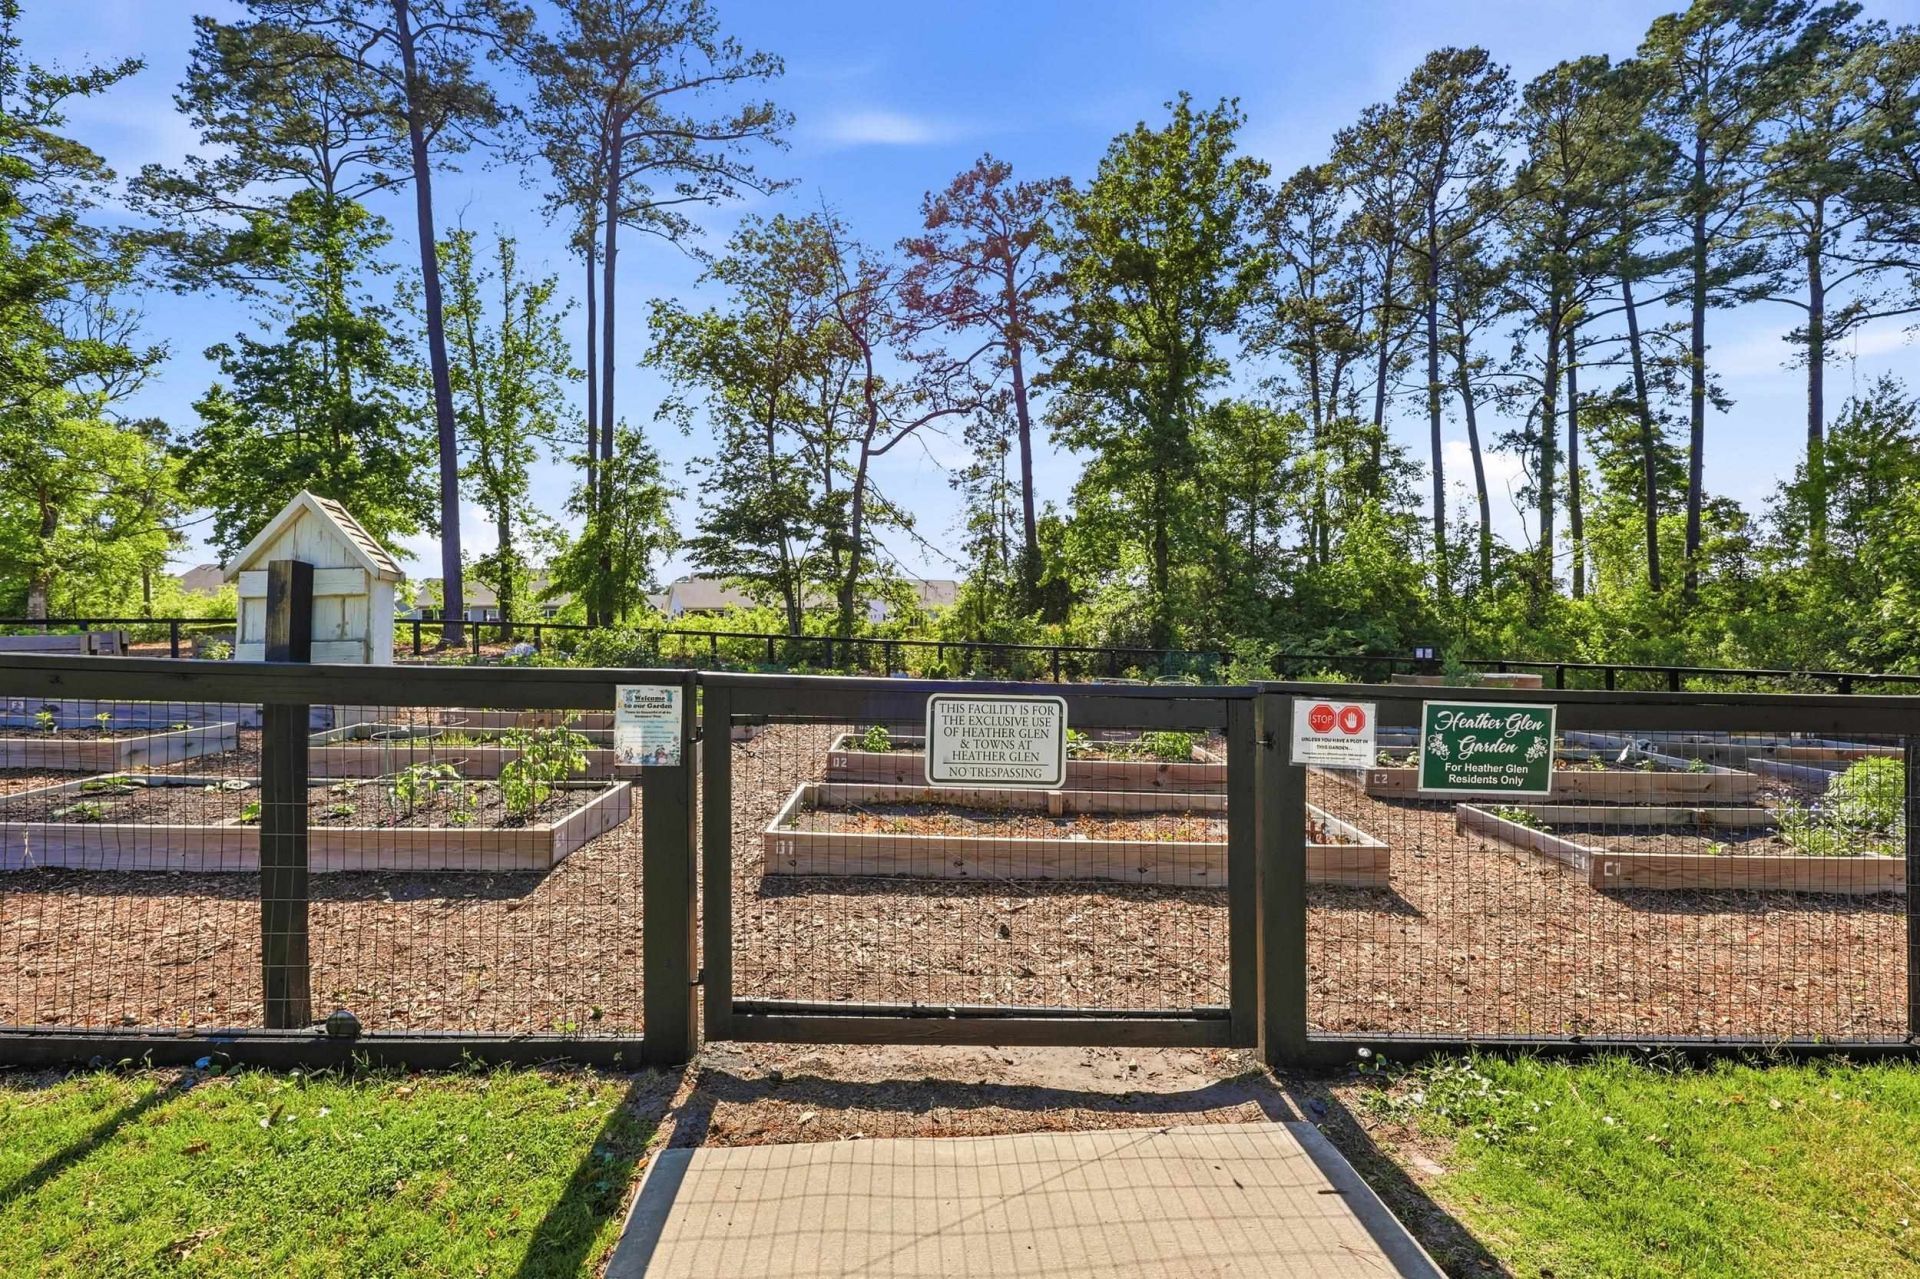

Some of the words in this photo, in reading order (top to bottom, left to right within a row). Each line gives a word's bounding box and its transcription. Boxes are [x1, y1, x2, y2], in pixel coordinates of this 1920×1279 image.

[939, 703, 965, 714] THIS
[968, 704, 1017, 715] FACILITY
[1020, 705, 1029, 716] IS
[1032, 706, 1055, 716] FOR
[941, 715, 966, 726] THE
[968, 715, 1029, 727] EXCLUSIVE
[1032, 717, 1051, 727] USE
[1312, 714, 1333, 724] STOP
[1434, 710, 1505, 732] Heather
[1503, 713, 1545, 738] Glen
[943, 727, 960, 737] OF
[962, 727, 1015, 738] HEATHER
[1018, 728, 1049, 739] GLEN
[960, 739, 970, 749] &
[973, 739, 1015, 750] TOWNS
[1018, 740, 1033, 750] AT
[1457, 735, 1519, 760] Garden
[952, 750, 1006, 761] HEATHER
[1009, 751, 1040, 762] GLEN
[949, 766, 967, 777] NO
[970, 767, 1042, 778] TRESPASSING
[1444, 762, 1462, 772] For
[1464, 763, 1503, 773] Heather
[1505, 764, 1528, 774] Glen
[1374, 773, 1388, 784] C2
[1448, 774, 1498, 784] Residents
[1500, 775, 1524, 787] Only
